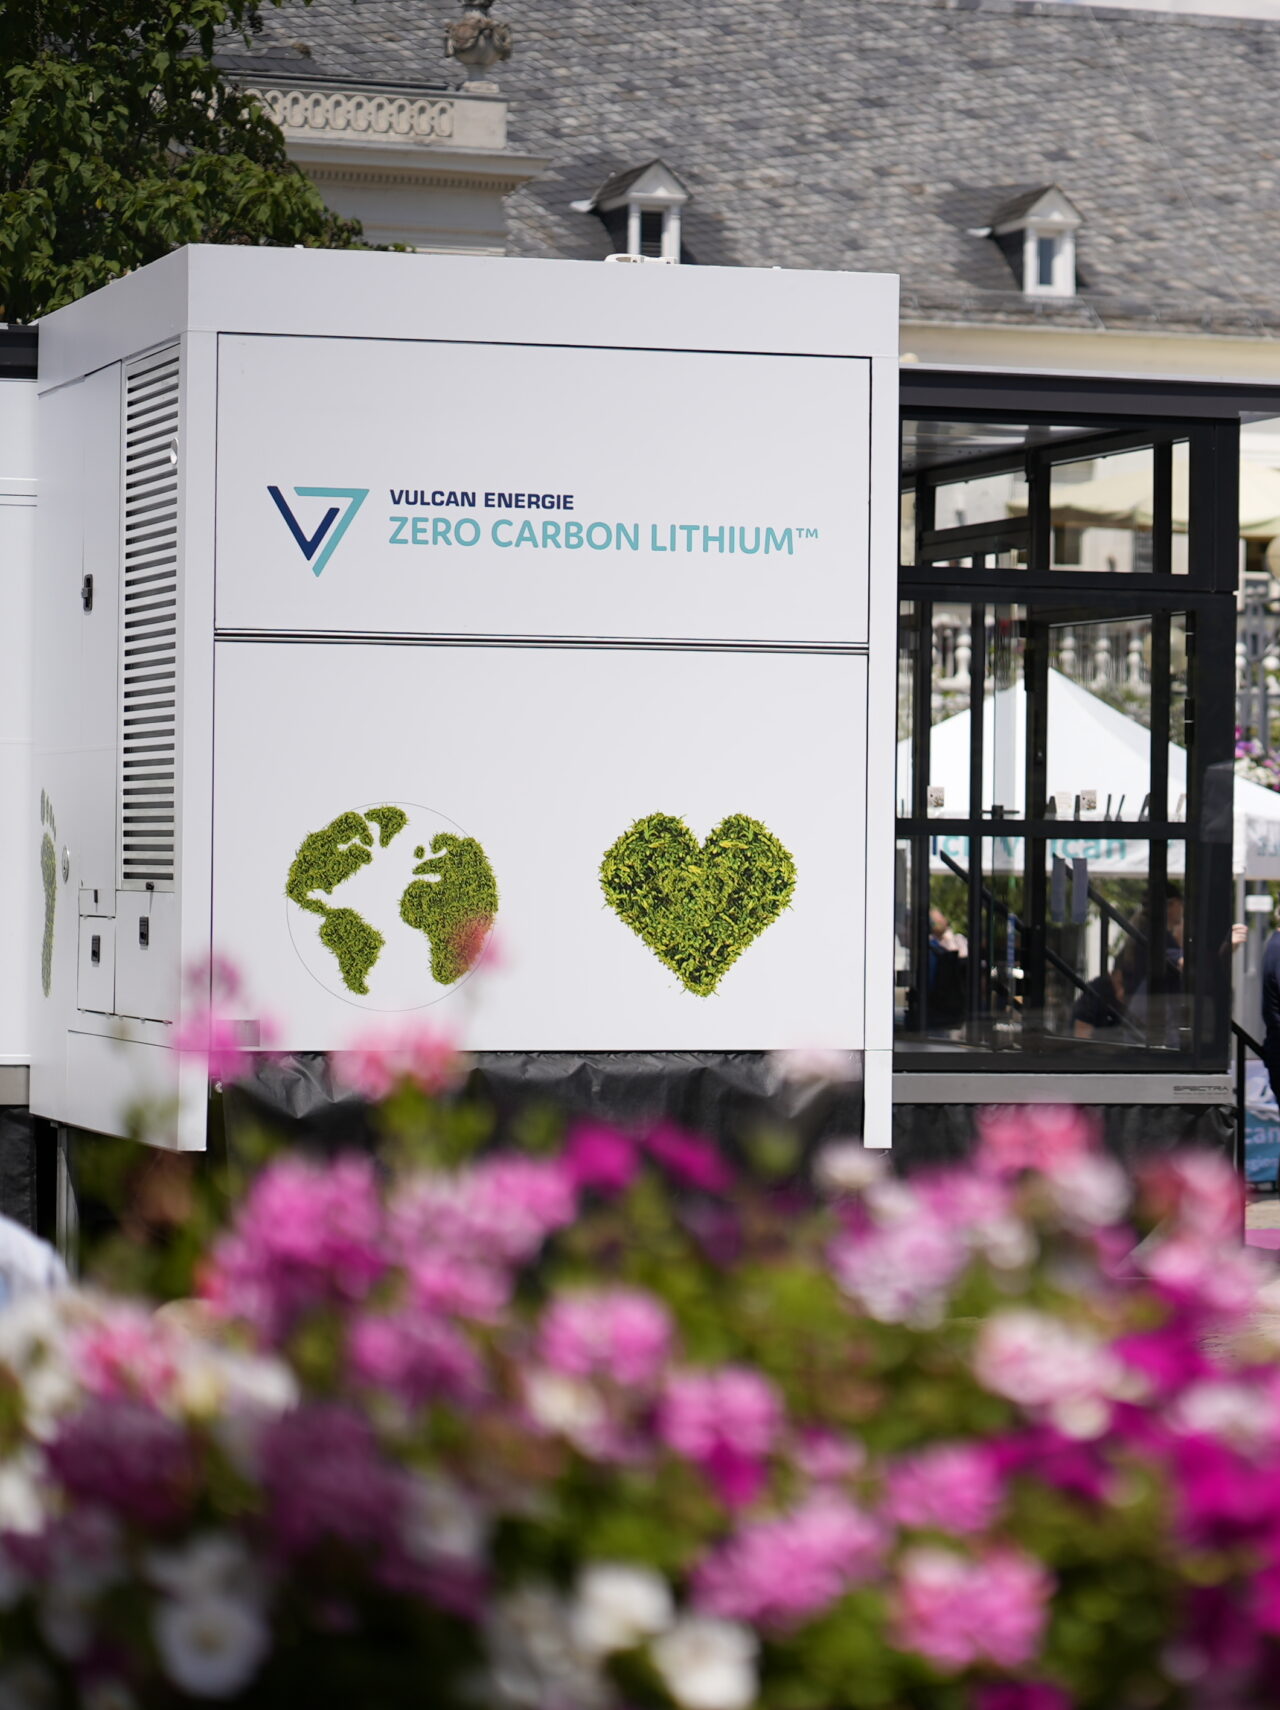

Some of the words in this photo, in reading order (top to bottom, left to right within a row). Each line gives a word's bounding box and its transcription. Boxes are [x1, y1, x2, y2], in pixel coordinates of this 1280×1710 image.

[389, 488, 477, 508] VULCAN
[483, 491, 575, 511] ENERGIE
[388, 515, 482, 547] ZERO
[491, 518, 640, 552] CARBON
